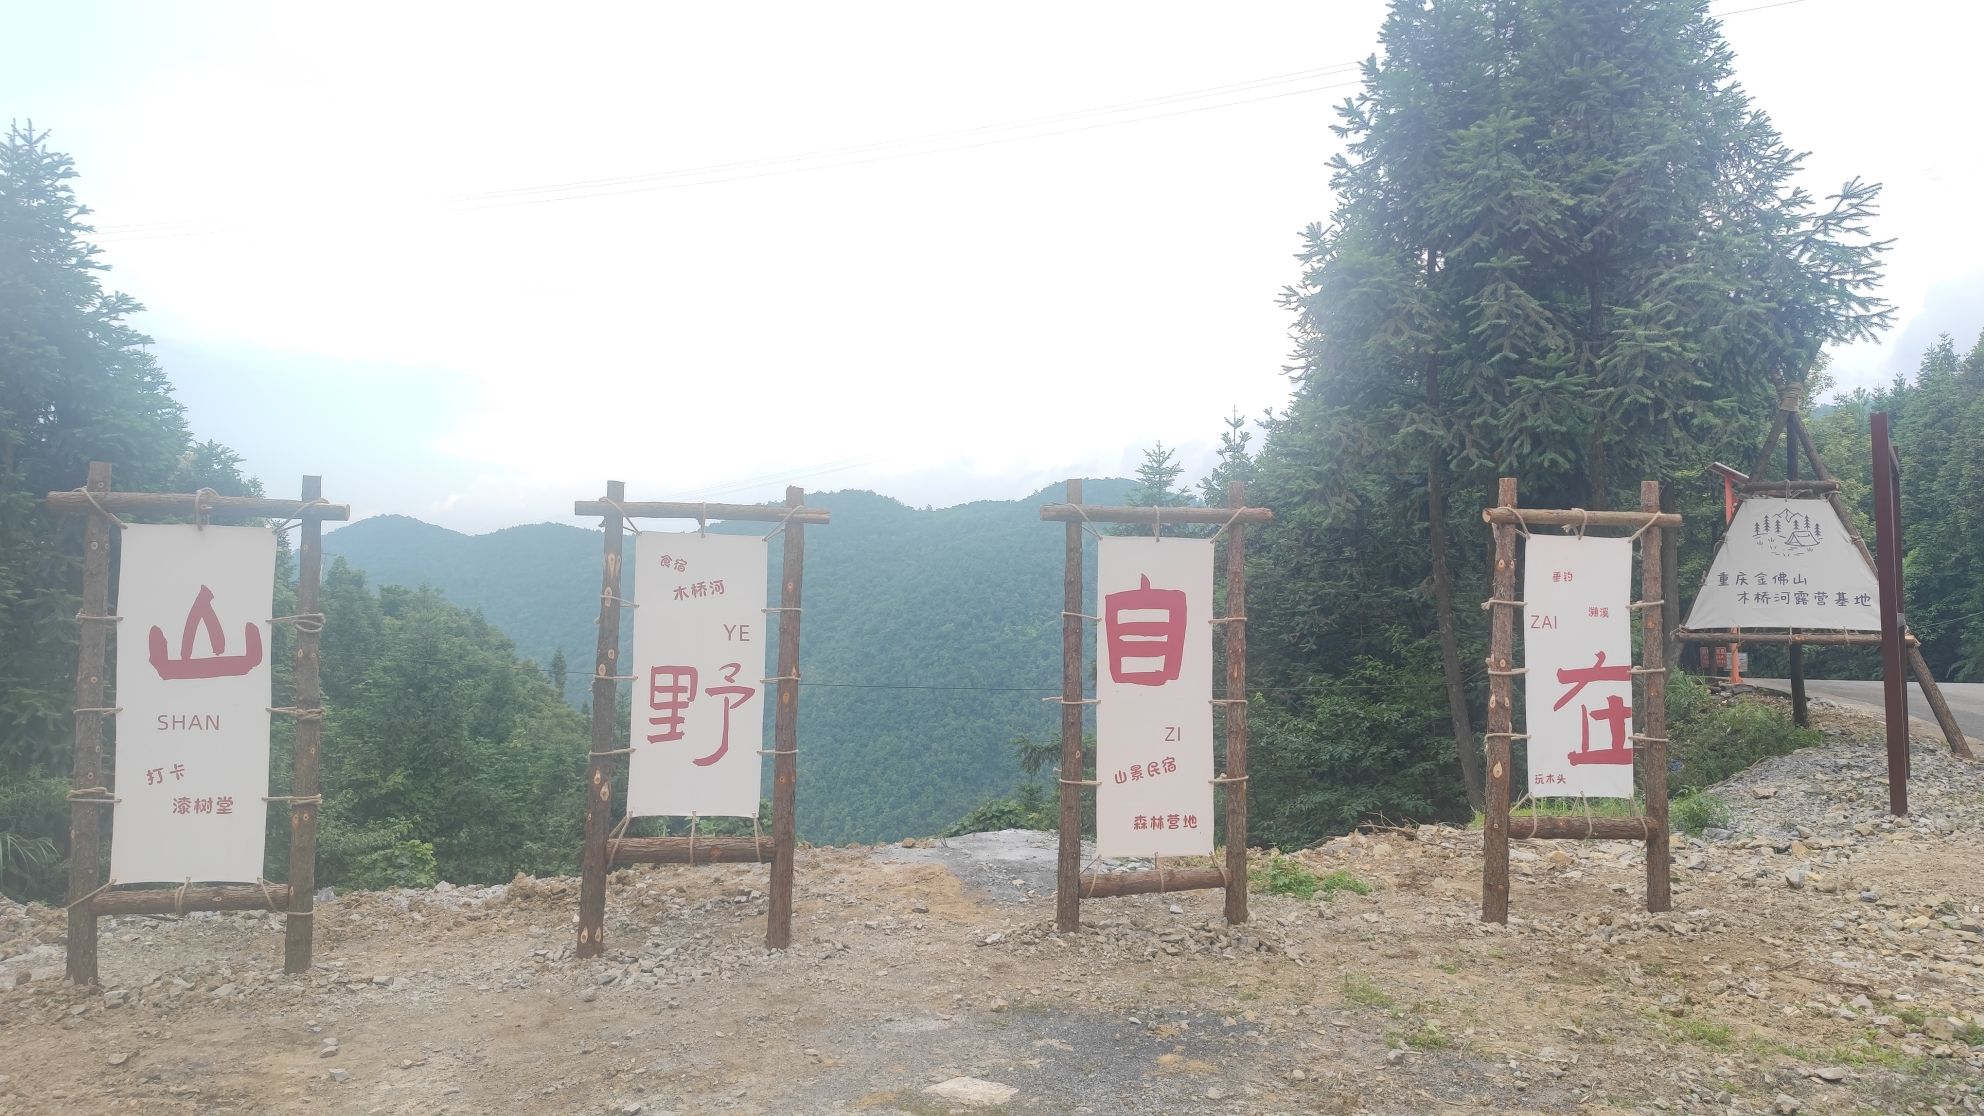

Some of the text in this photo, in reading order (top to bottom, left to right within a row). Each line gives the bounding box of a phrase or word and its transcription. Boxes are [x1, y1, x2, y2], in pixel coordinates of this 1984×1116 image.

[660, 554, 688, 573] 食宿
[1717, 571, 1808, 587] 重庆金佛山
[673, 579, 725, 601] 木桥河
[1737, 590, 1873, 607] 木桥河露营基地
[1104, 573, 1188, 687] 自
[1530, 614, 1558, 630] ZAI
[148, 584, 263, 680] 山
[723, 623, 750, 642] YE
[647, 662, 756, 767] 野
[1553, 650, 1633, 766] 在
[157, 714, 221, 731] SHAN
[1164, 726, 1181, 742] ZI
[146, 763, 186, 786] 打卡
[1114, 756, 1178, 785] 山景民宿
[1534, 773, 1567, 785] 玩木头
[172, 796, 234, 816] 漆树堂
[1133, 813, 1198, 831] 森林营地
